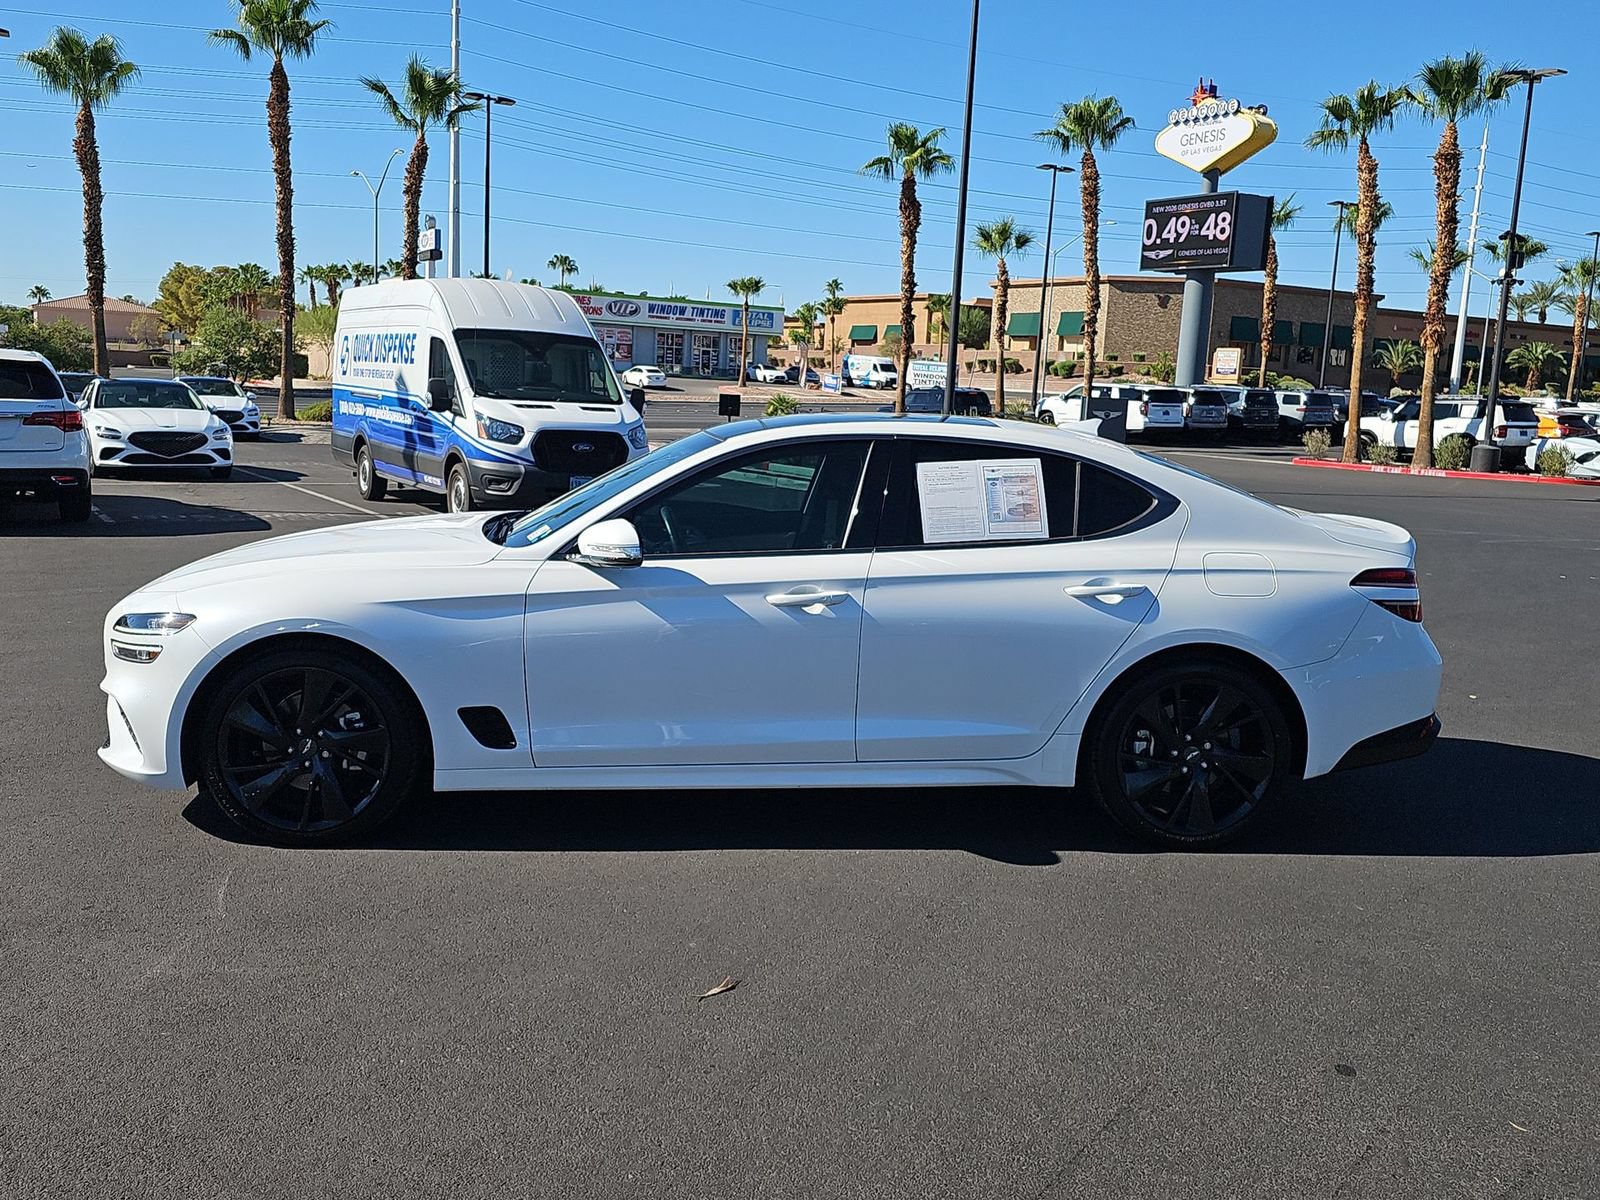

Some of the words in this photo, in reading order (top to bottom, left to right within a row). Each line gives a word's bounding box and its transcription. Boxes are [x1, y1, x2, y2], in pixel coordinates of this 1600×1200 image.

[1170, 100, 1237, 120] WELCOME
[1180, 127, 1226, 147] GENESIS
[1202, 145, 1222, 153] VEGAS
[1177, 202, 1199, 211] GENESIS
[1143, 215, 1190, 246] 0.49
[1200, 211, 1232, 240] 48
[1178, 249, 1196, 257] GENESIS
[611, 302, 636, 314] VIP
[648, 303, 687, 316] WINDOW
[691, 306, 727, 319] TINTING
[353, 333, 375, 363] QUICK
[375, 333, 417, 364] DISPENSE
